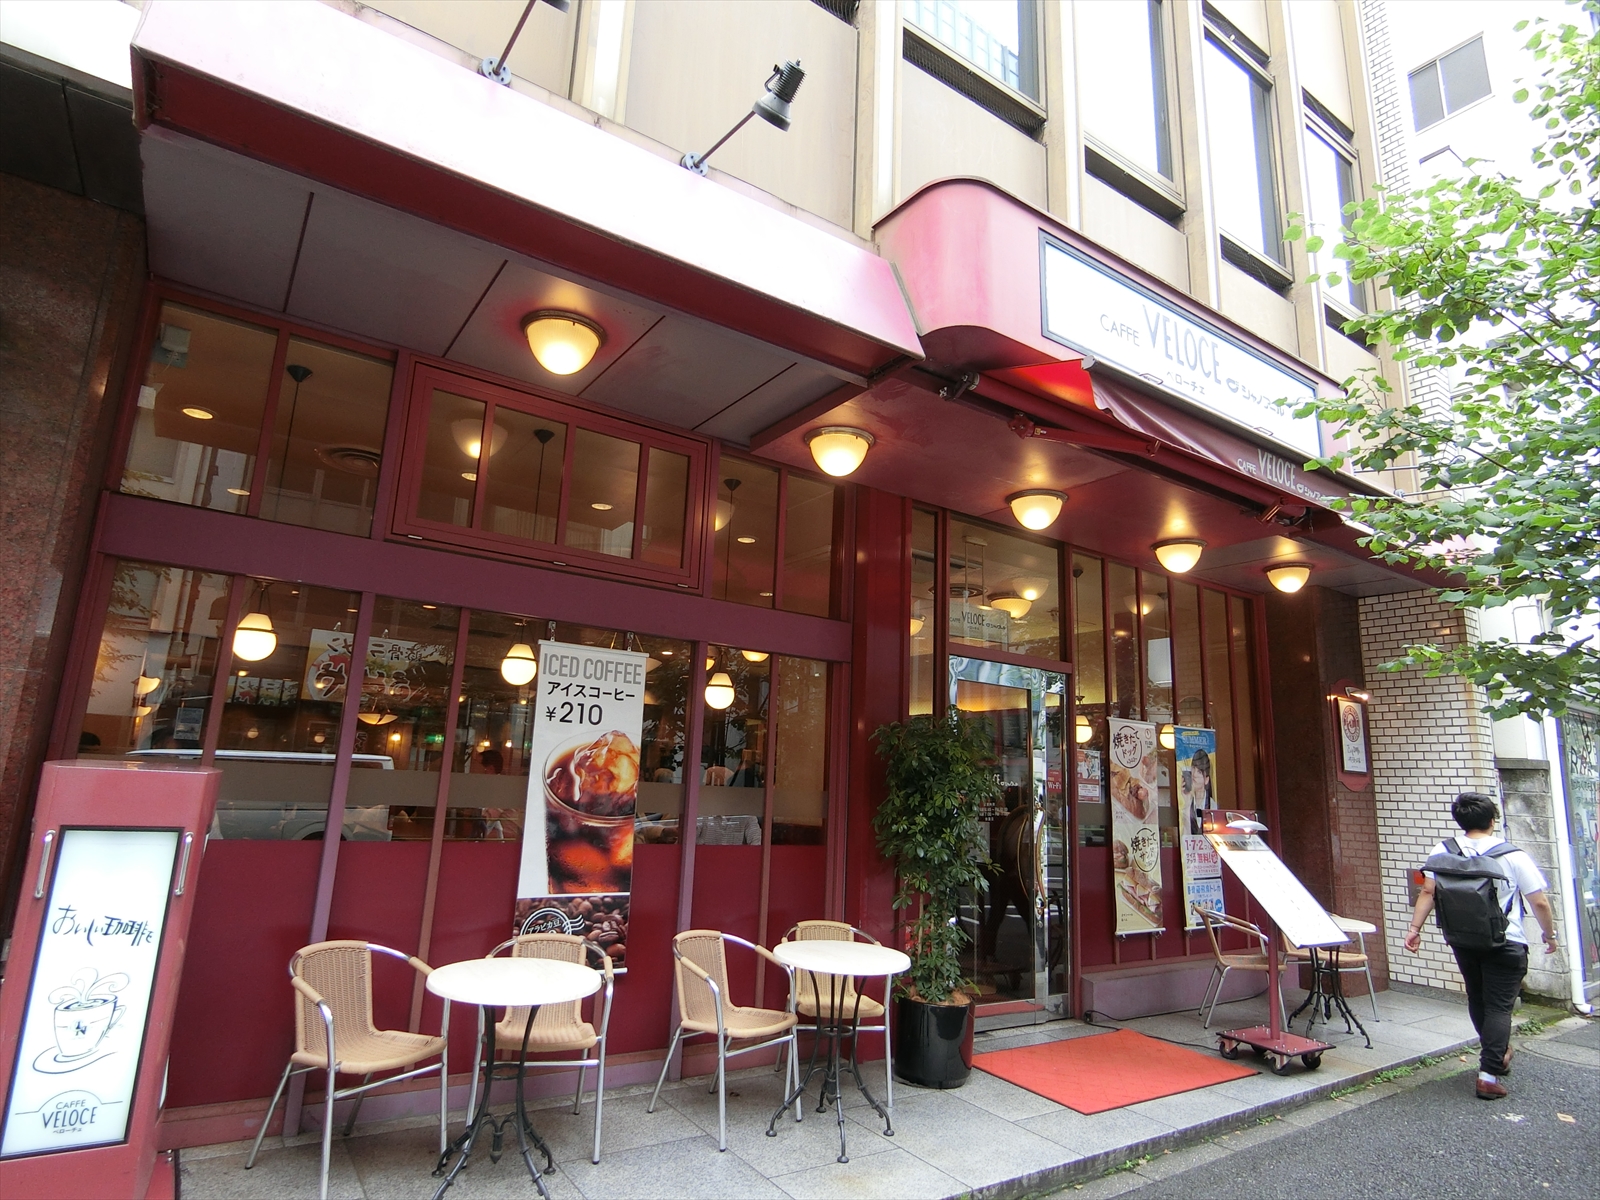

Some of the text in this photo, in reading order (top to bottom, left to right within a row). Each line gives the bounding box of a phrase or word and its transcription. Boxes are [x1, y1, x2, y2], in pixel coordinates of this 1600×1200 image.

[1100, 304, 1222, 385] CAFFE VELOCE
[1237, 448, 1296, 490] CAFFE VELOCE
[961, 610, 985, 627] VELOCE
[542, 652, 643, 685] ICED COFFEE
[547, 681, 636, 702] アイスコーヒー
[545, 701, 603, 726] ¥210
[1113, 730, 1140, 750] 焼きたて
[1121, 743, 1138, 759] ドッグ
[1130, 832, 1157, 854] 焼きたて
[56, 1099, 86, 1110] CAFFE
[42, 1105, 96, 1130] VELOCE
